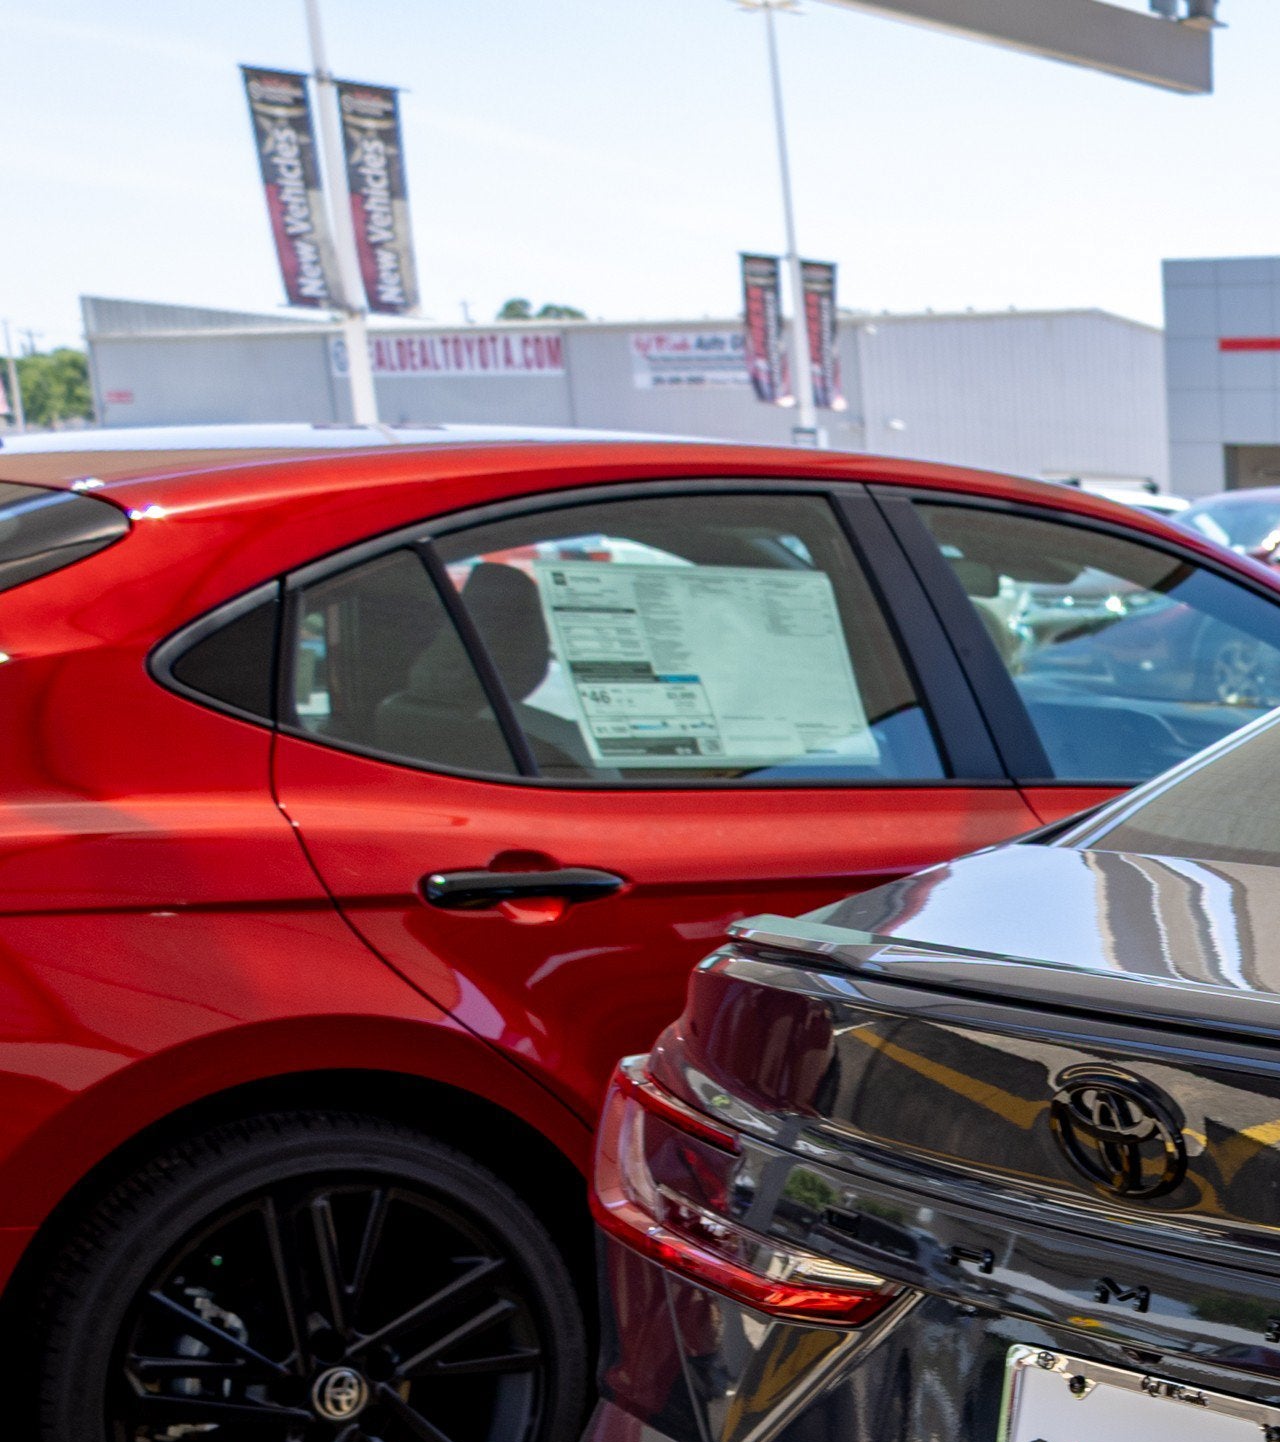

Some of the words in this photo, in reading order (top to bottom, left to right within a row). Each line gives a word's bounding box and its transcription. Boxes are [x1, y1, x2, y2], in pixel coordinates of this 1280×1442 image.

[271, 126, 312, 236] Vehicles
[357, 138, 395, 244] Vehicles
[294, 239, 327, 297] New
[374, 249, 405, 304] New
